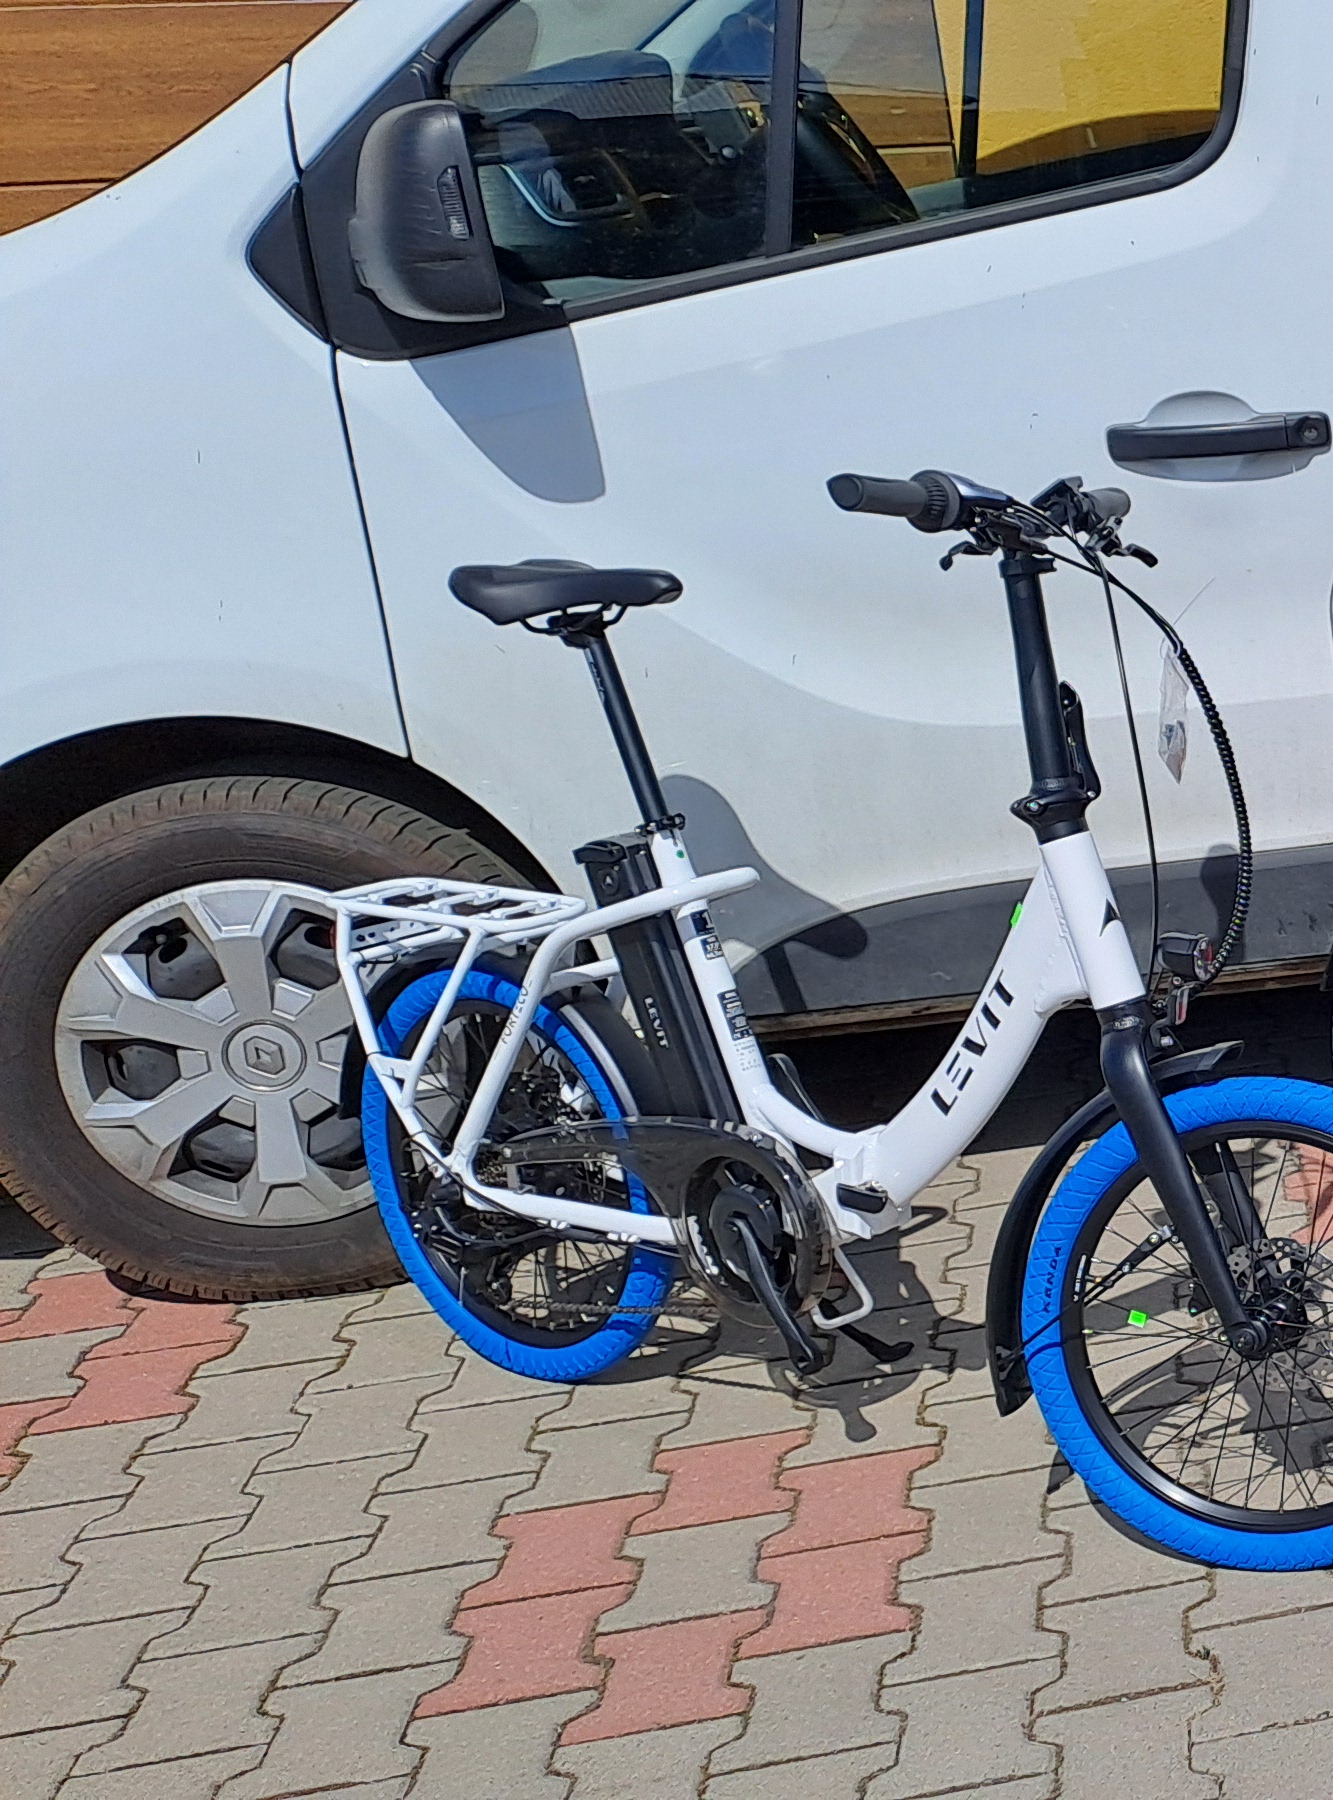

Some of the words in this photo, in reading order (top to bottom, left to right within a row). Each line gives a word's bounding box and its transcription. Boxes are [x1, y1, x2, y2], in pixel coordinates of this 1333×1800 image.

[501, 984, 529, 1045] FORTECO
[643, 996, 670, 1049] LEVIT
[930, 966, 1015, 1117] LEVIT
